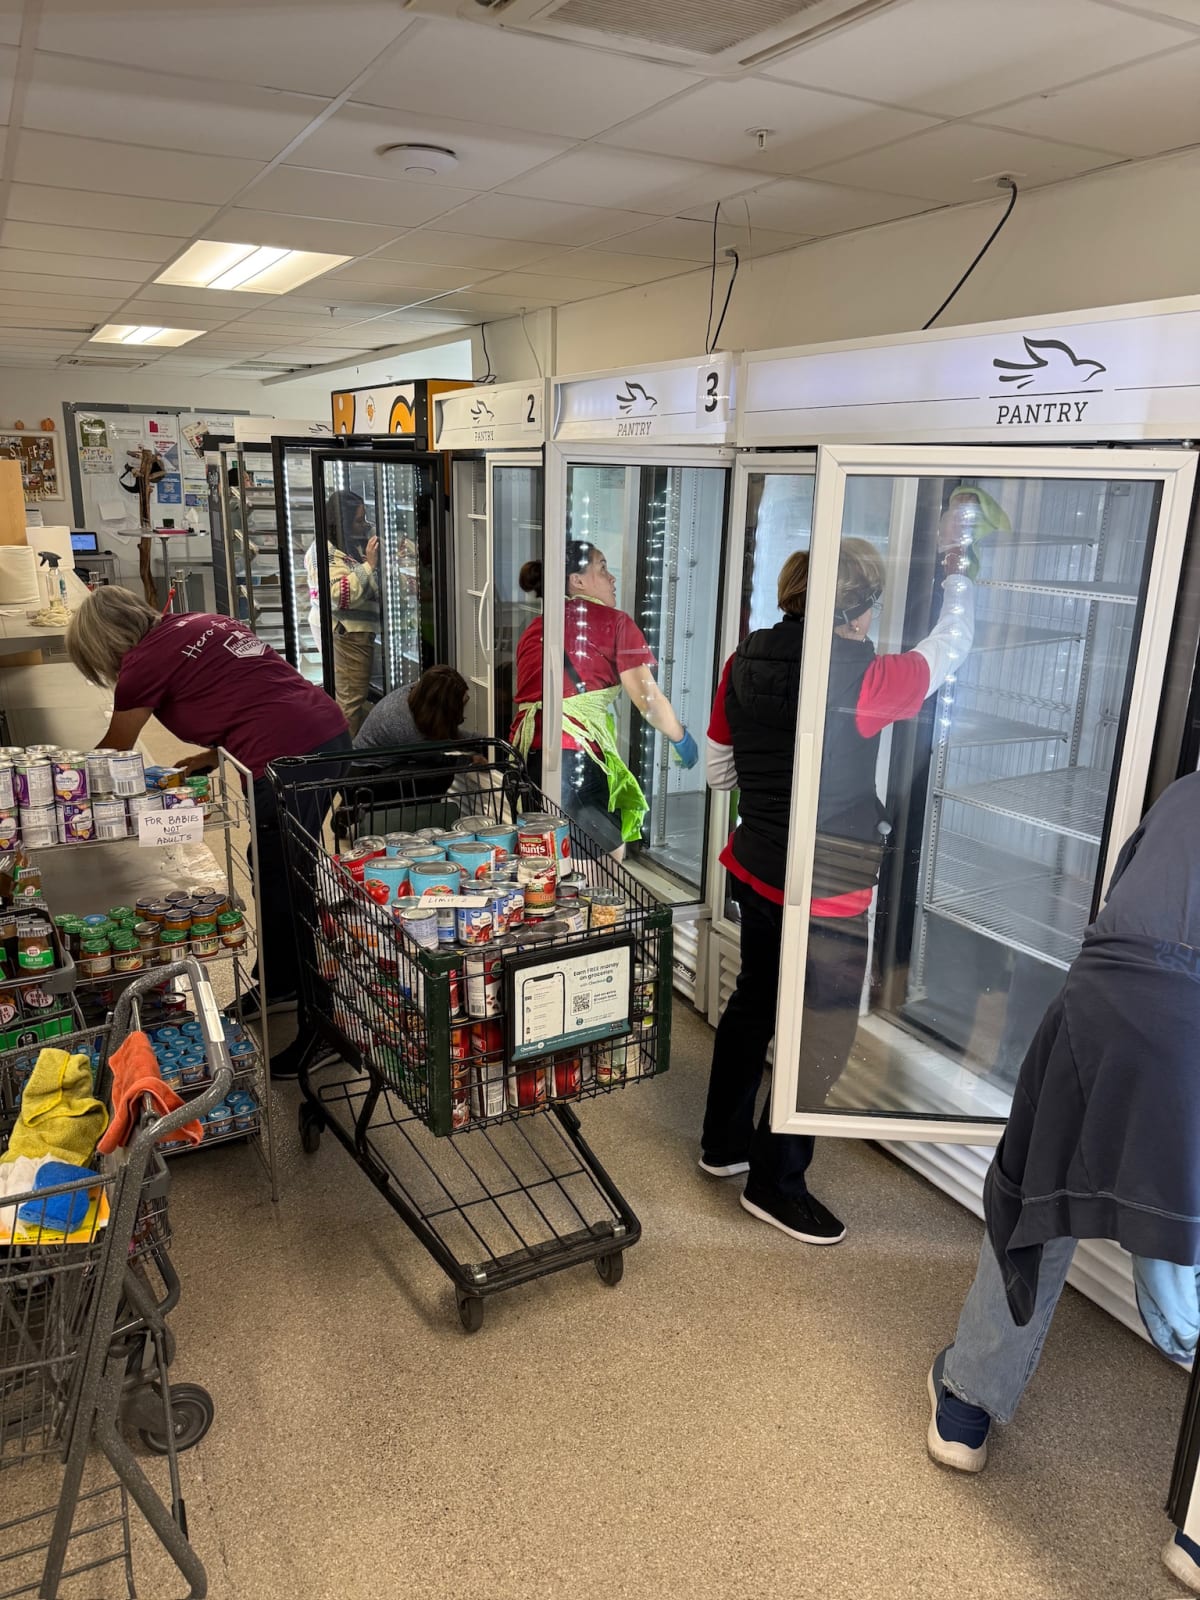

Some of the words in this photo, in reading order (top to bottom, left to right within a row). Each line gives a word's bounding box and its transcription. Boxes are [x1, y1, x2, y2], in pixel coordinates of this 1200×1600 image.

[704, 371, 719, 413] 3
[527, 394, 536, 423] 2
[996, 401, 1089, 425] PANTRY
[616, 421, 652, 437] PANTRY
[474, 430, 494, 441] PANTRY
[144, 816, 163, 826] FOR
[168, 815, 199, 825] BABIES
[163, 825, 183, 833] NOT
[599, 962, 619, 971] money
[20, 1033, 34, 1045] 12
